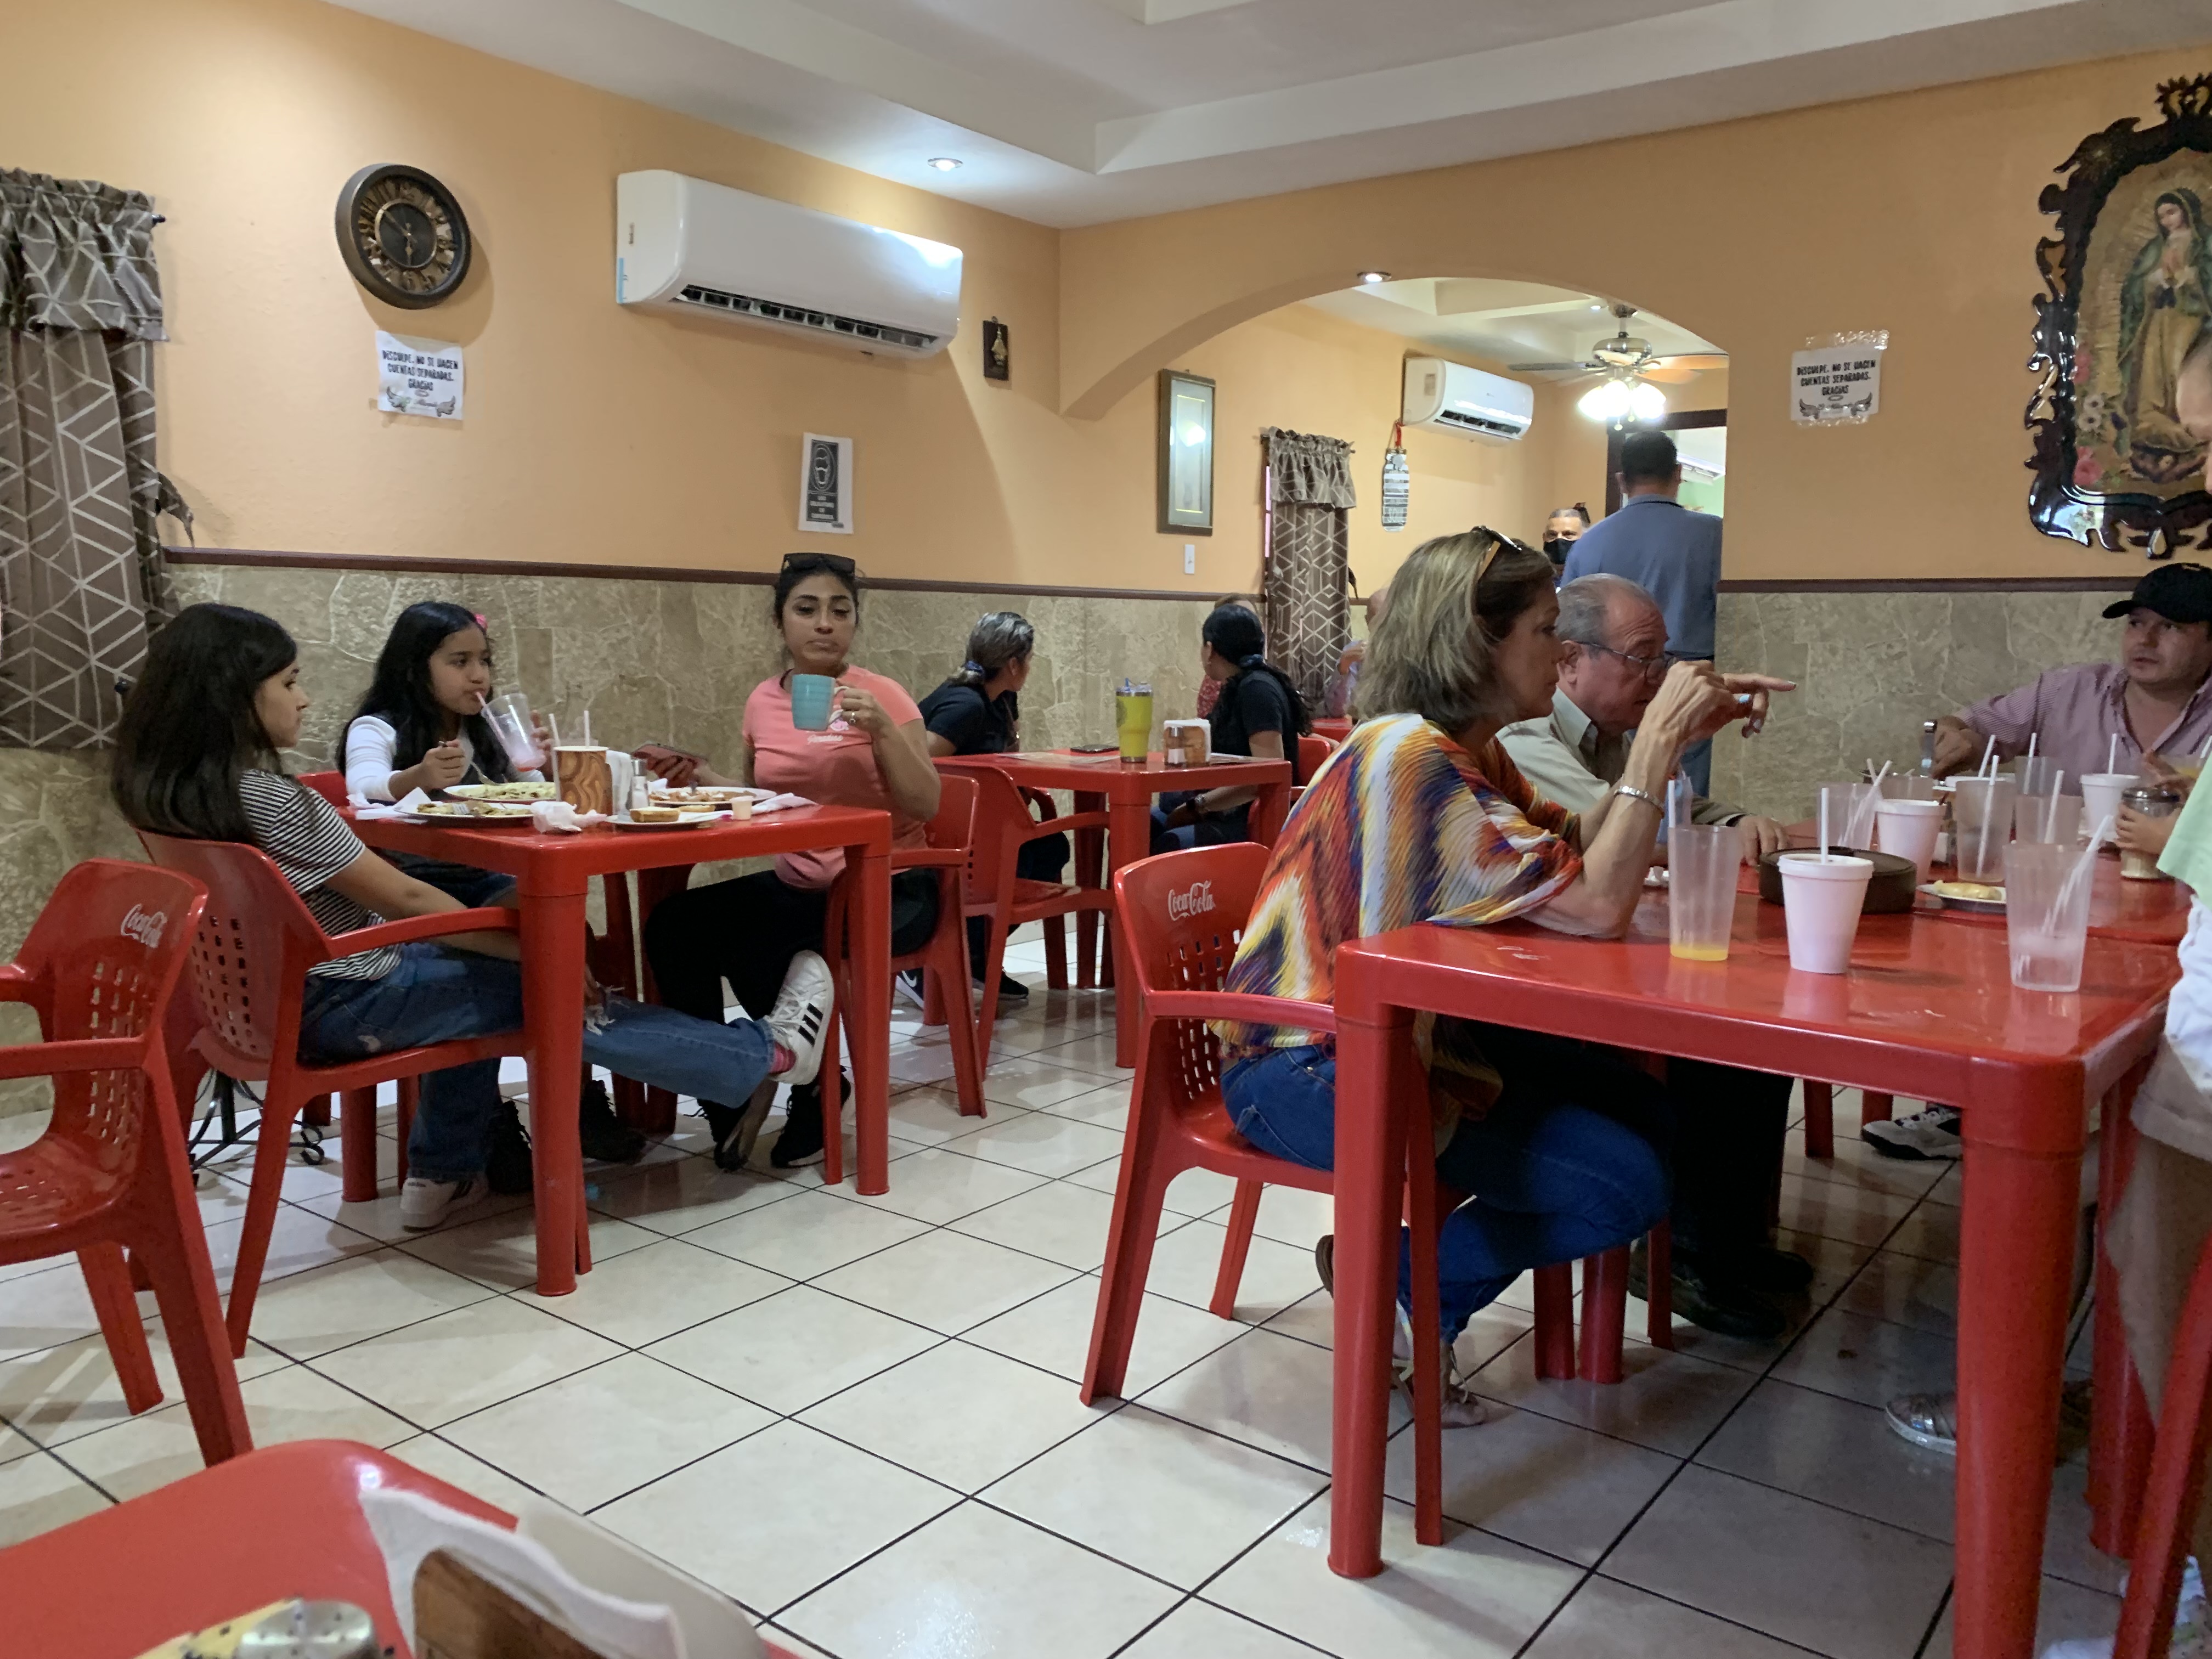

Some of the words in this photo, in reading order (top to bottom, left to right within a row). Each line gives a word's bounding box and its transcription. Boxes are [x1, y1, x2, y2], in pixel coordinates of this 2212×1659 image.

[1832, 363, 1841, 371] NO
[1801, 375, 1830, 386] CUENTAS
[1822, 385, 1849, 396] GRACIAS
